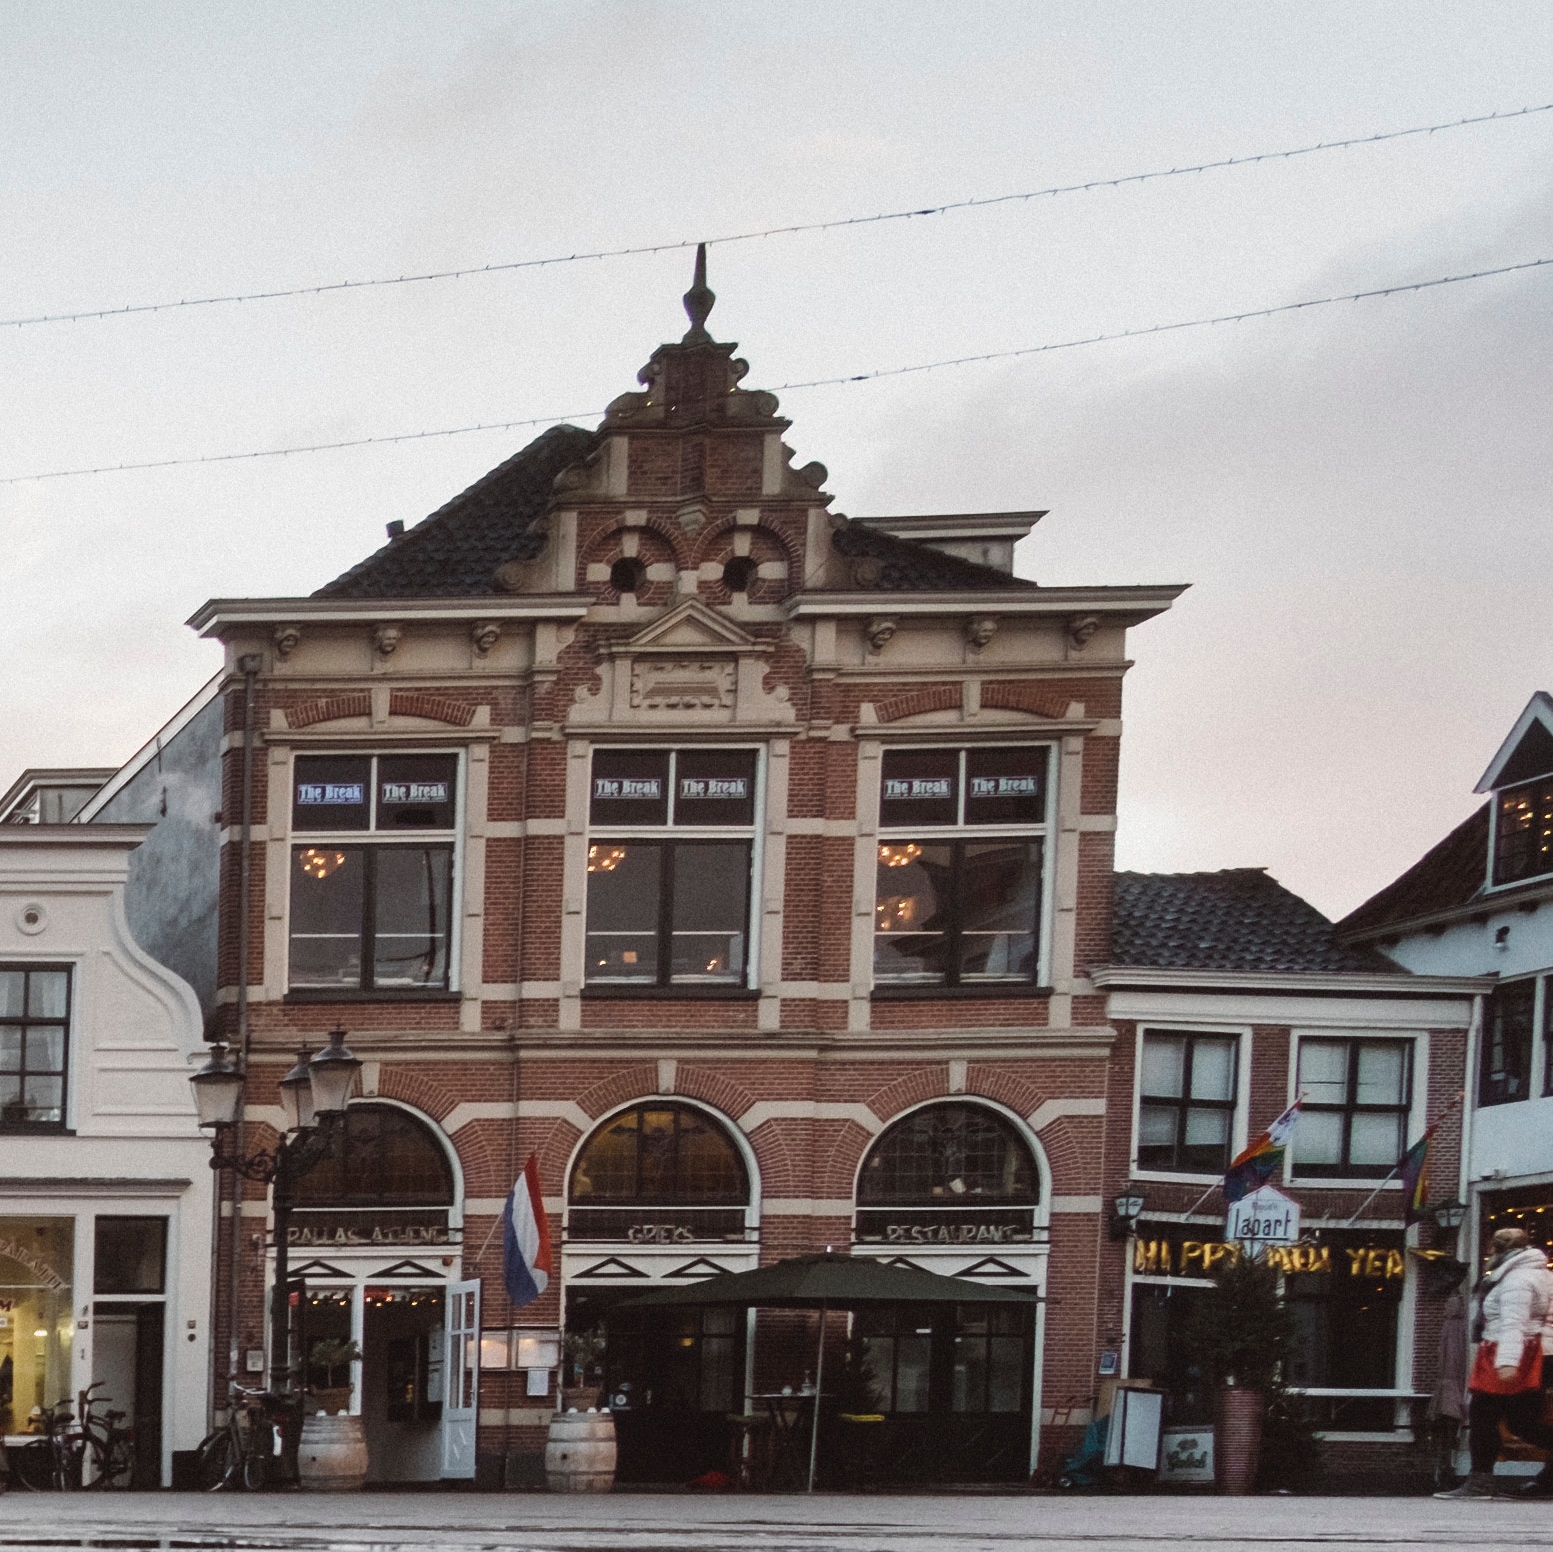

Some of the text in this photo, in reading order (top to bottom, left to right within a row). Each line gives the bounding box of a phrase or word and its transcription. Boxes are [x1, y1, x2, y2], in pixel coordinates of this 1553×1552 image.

[300, 784, 360, 799] The Break
[384, 784, 445, 798] The Break
[596, 780, 658, 793] The Break
[683, 779, 744, 793] The Break
[886, 780, 948, 794] The Break
[972, 778, 1034, 792] The Break
[287, 1227, 362, 1244] PALLAS
[628, 1225, 694, 1244] GRIEKS
[886, 1225, 1019, 1244] RESTAURANT
